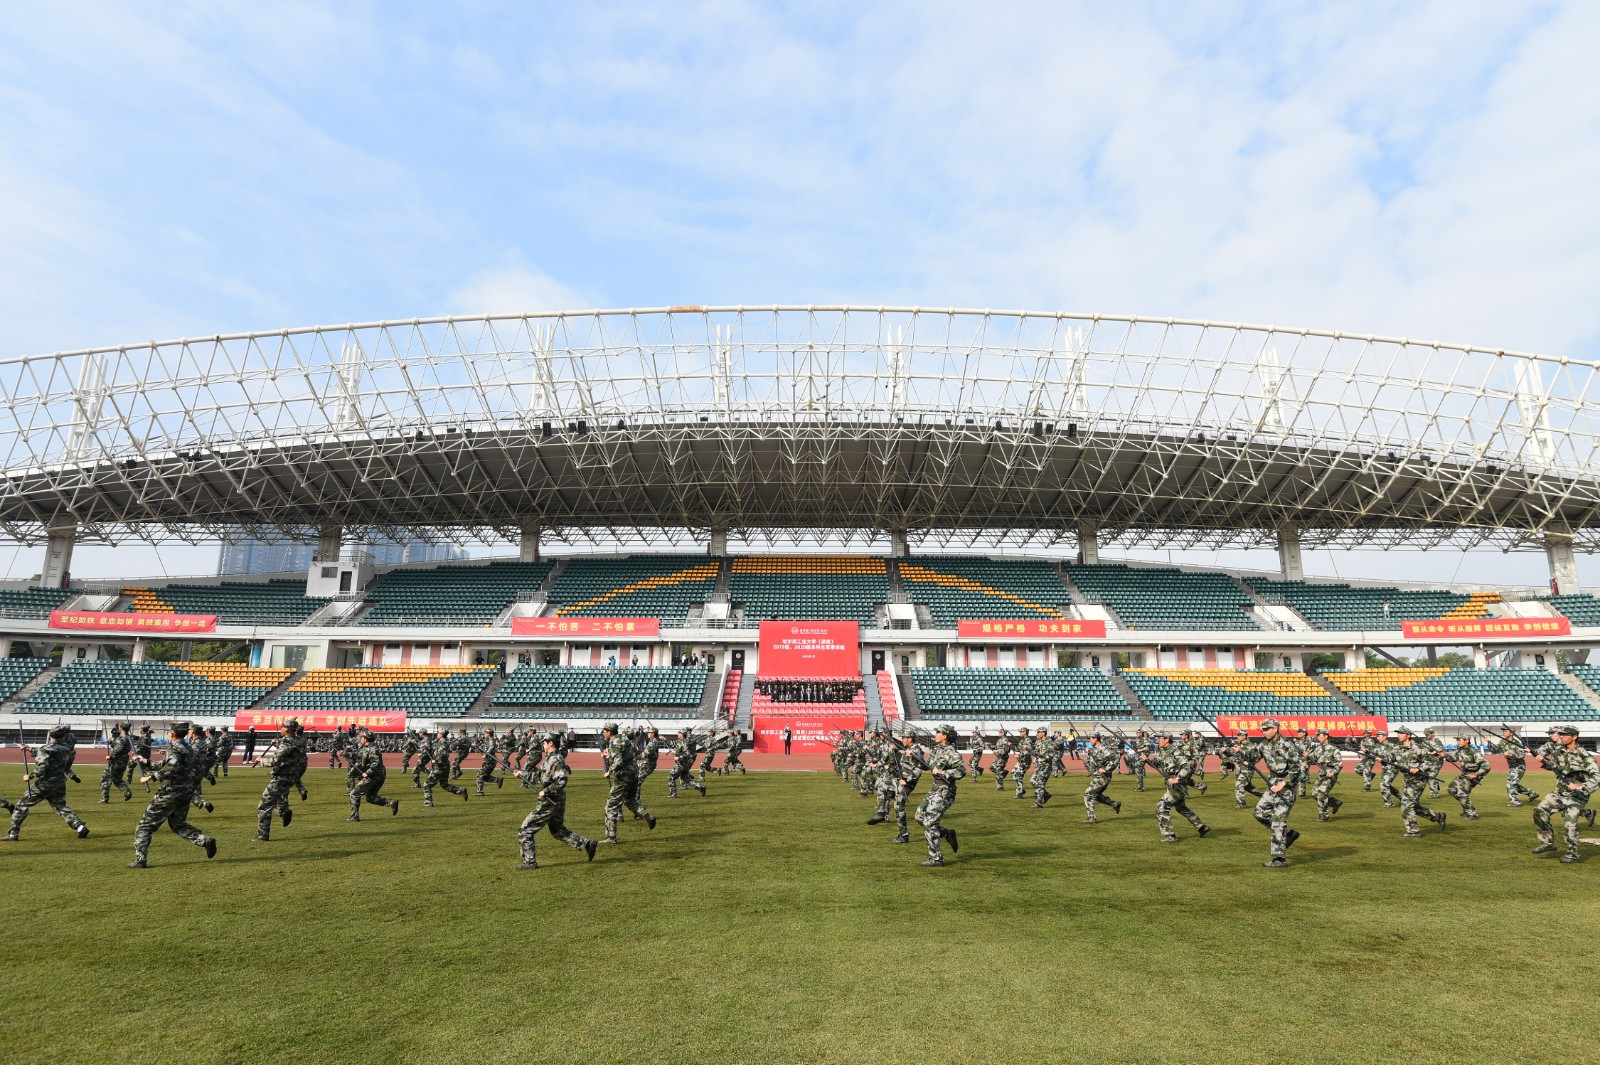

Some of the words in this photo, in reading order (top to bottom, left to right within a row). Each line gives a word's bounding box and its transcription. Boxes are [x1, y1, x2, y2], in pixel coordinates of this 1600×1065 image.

[535, 622, 580, 631] 一不怕苦
[591, 622, 636, 631] 二不怕累
[982, 624, 1026, 633] 规格严格
[1039, 624, 1082, 633] 功夫到家
[1412, 625, 1445, 633] 服从命令
[1485, 623, 1520, 632] 团结互助
[326, 715, 388, 725] 争创先进连队
[1229, 720, 1299, 730] 流血流流泪
[1307, 721, 1377, 731] 掉皮掉肉不掉队
